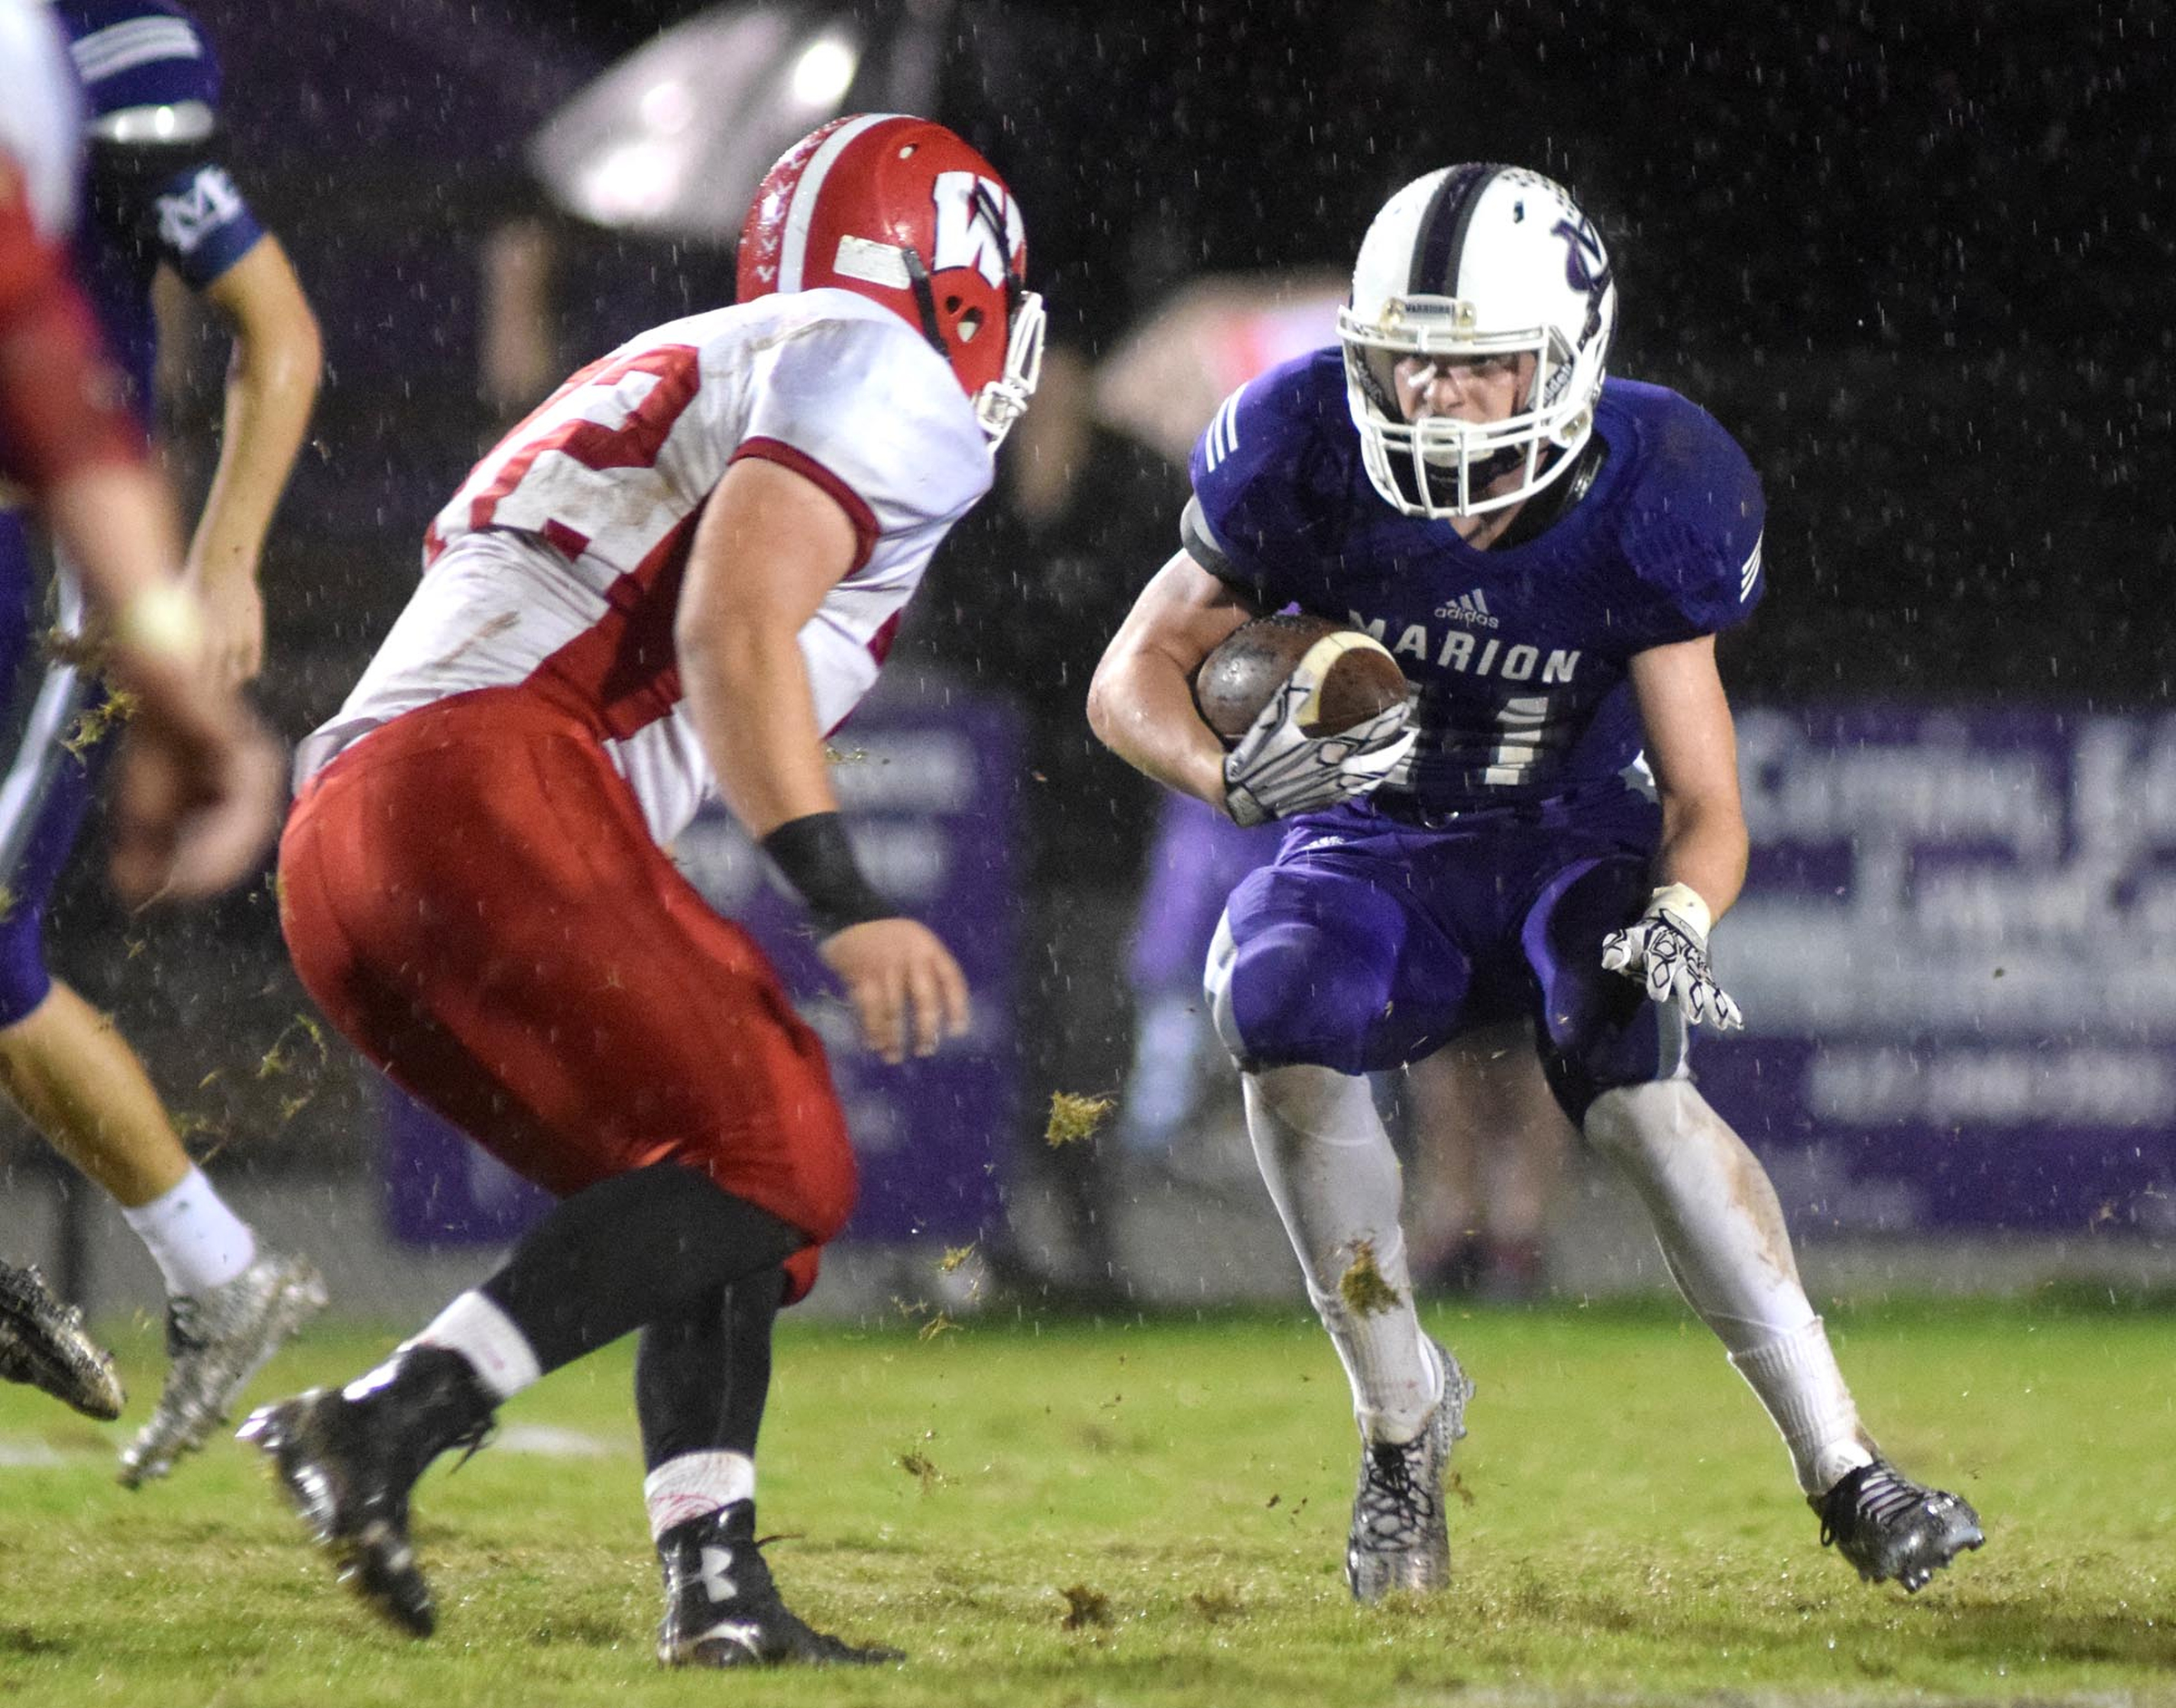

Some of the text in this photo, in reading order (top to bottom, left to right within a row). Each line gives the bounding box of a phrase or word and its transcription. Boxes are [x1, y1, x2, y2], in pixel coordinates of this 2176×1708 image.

[932, 170, 1025, 289] W
[1349, 609, 1580, 684] MARION
[1433, 605, 1499, 628] adidas
